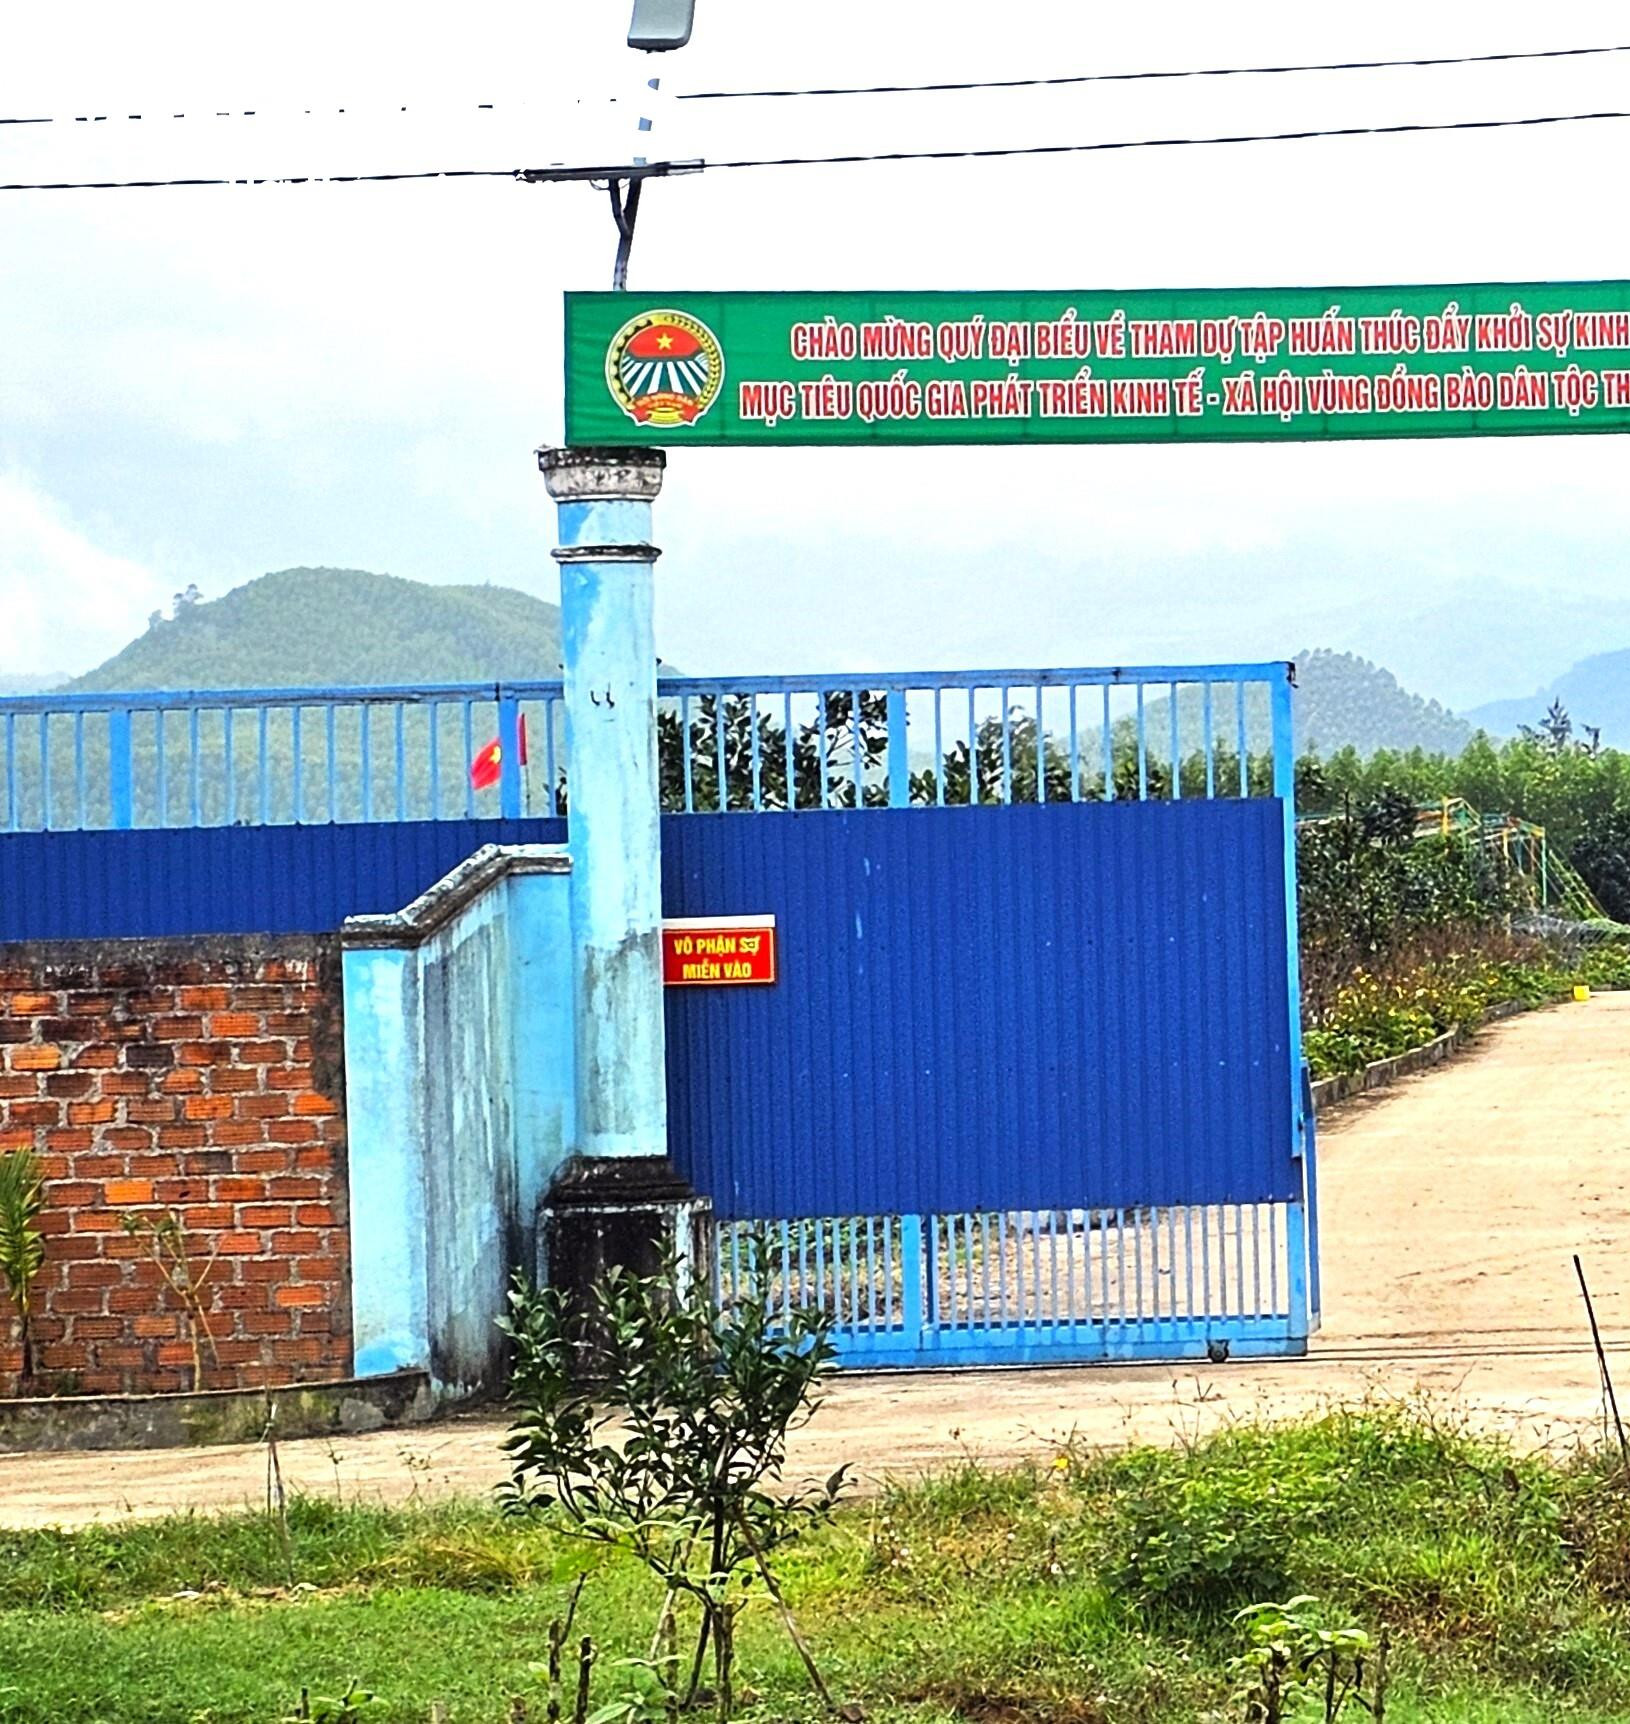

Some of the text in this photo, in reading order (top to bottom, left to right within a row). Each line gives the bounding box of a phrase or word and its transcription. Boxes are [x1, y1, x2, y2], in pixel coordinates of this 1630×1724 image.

[791, 316, 857, 360] CHÀO
[860, 314, 934, 360] MỪNG
[936, 314, 986, 363] QUÝ
[988, 321, 1031, 366] ĐẠI
[1034, 308, 1090, 358] BIỂU
[1094, 309, 1126, 358] VỀ
[1128, 319, 1198, 358] THAM
[1201, 316, 1238, 364] DỰ
[1238, 311, 1286, 363] TẬP
[1289, 306, 1355, 354] HUẤN
[1359, 309, 1420, 354] THÚC
[1423, 302, 1472, 352] ĐẨY
[1475, 302, 1532, 351] KHỞI
[1536, 309, 1573, 357] SỰ
[1573, 311, 1630, 349] KINH
[739, 381, 797, 427] MỤC
[798, 373, 852, 419] TIÊU
[856, 368, 921, 423] QUỐC
[924, 382, 969, 418] GIA
[970, 372, 1034, 418] PHÁT
[1036, 365, 1107, 417] TRIỂN
[1110, 378, 1170, 417] KINH
[1171, 366, 1206, 417] TẾ
[1222, 370, 1258, 416] XÃ
[1260, 369, 1303, 422] HỘI
[1304, 368, 1372, 413] VÙNG
[1374, 362, 1442, 413] ĐỒNG
[1444, 365, 1494, 412] BÀO
[1497, 364, 1549, 410] DÂN
[1551, 363, 1601, 417] TỘC
[674, 935, 693, 955] VÔ
[696, 934, 736, 957] PHẬN
[723, 958, 752, 978] VÀO
